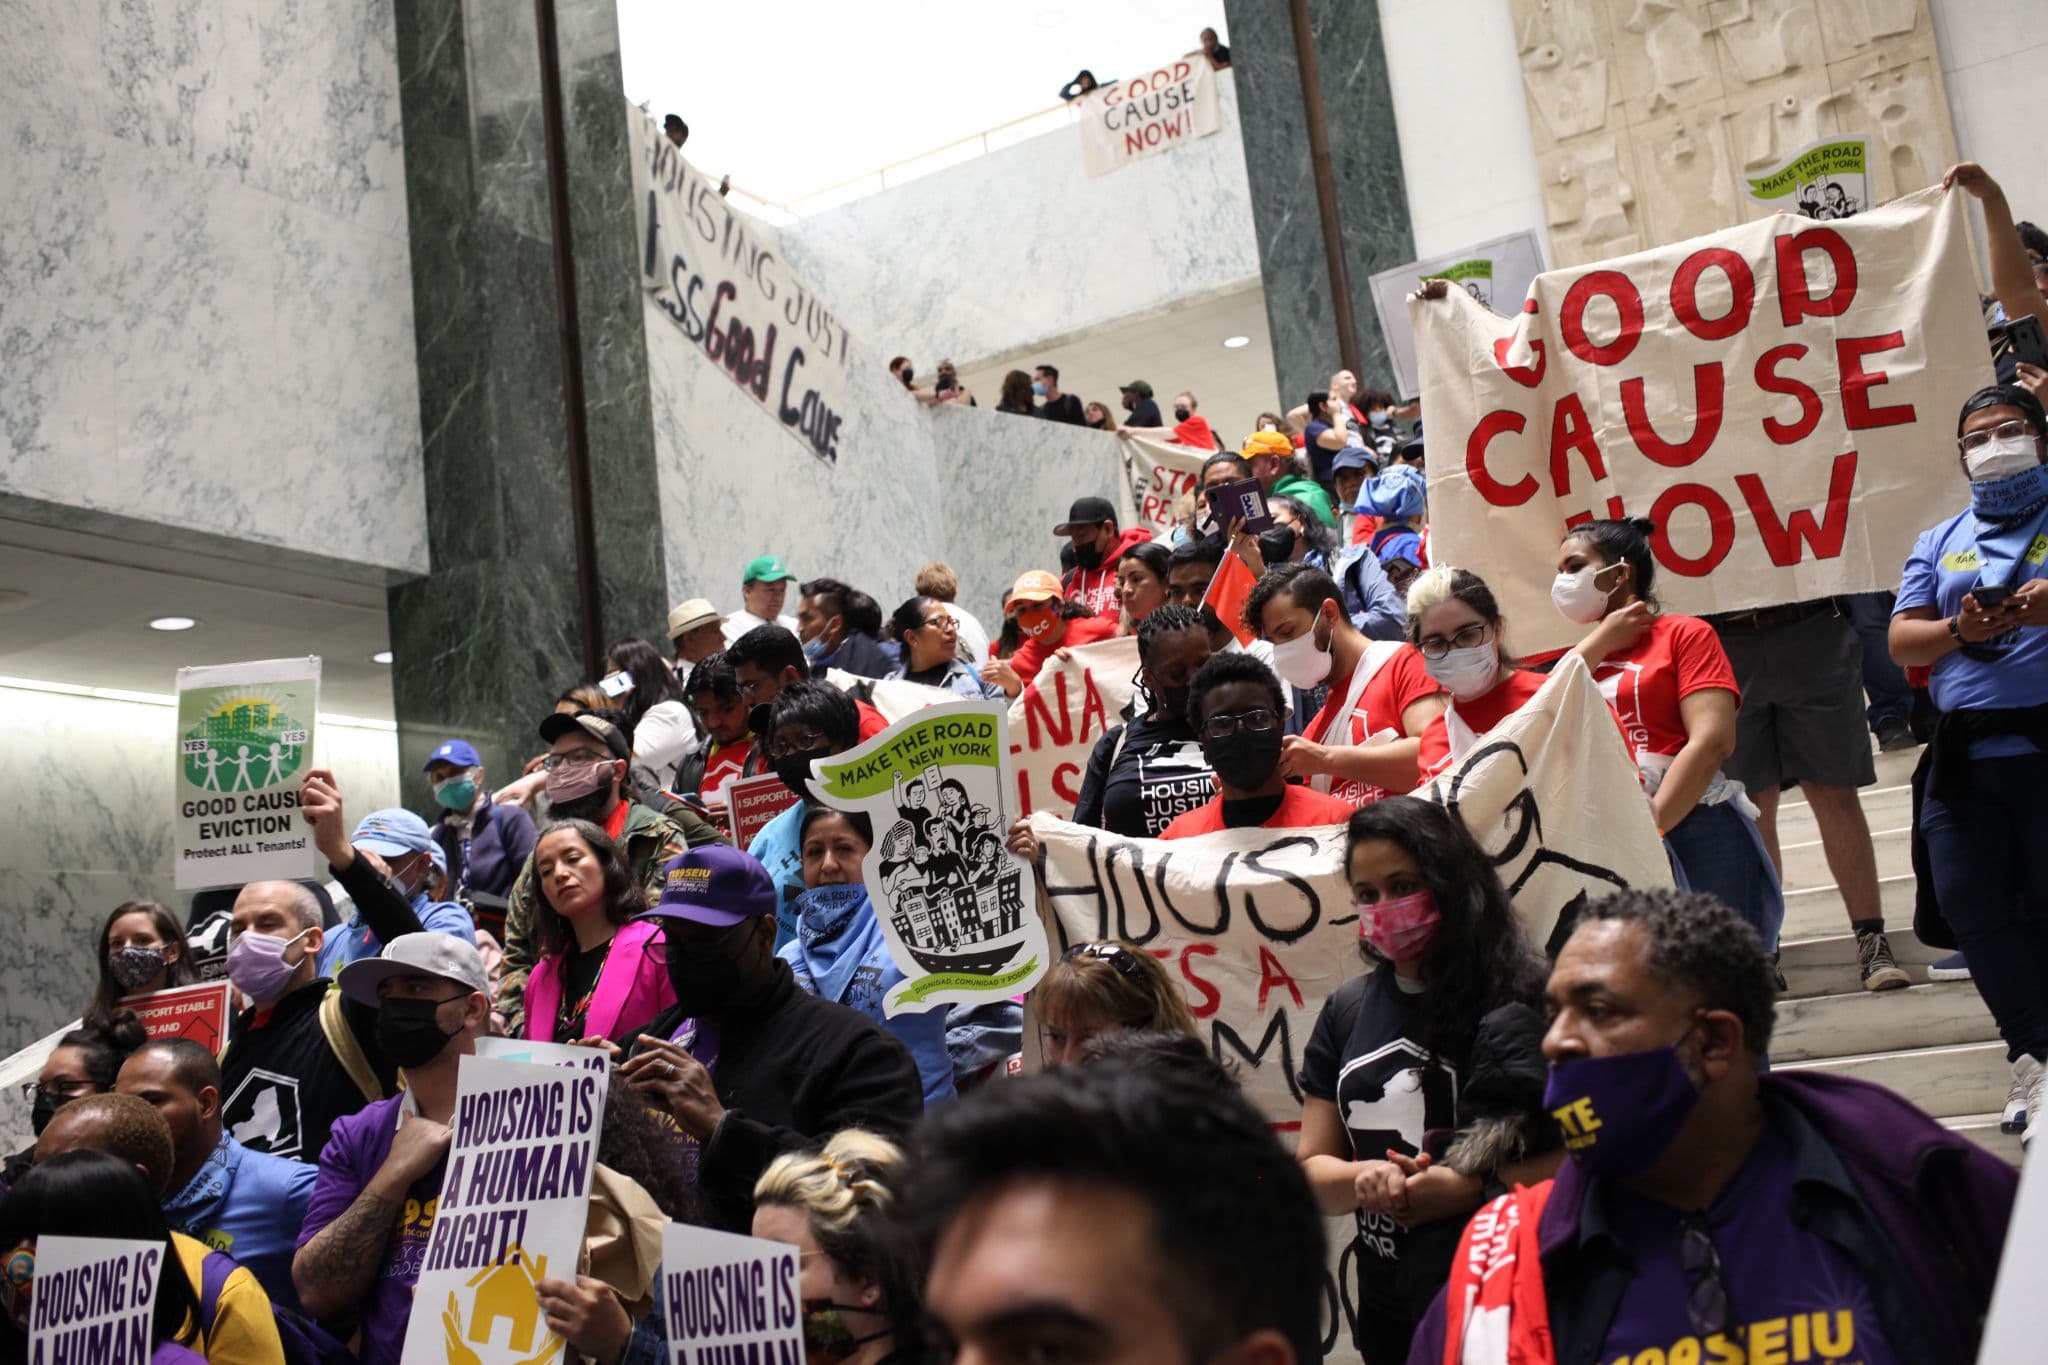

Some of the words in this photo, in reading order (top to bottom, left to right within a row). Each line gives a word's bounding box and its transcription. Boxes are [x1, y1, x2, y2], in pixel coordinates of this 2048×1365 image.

[1104, 62, 1190, 106] GOOD
[1104, 82, 1195, 130] CAUSE
[1125, 109, 1191, 155] NOW!
[1761, 169, 1796, 193] MAKE
[1795, 152, 1821, 173] THE
[1822, 146, 1862, 160] ROAD
[1806, 162, 1830, 179] NEW
[1833, 159, 1861, 169] YORK
[1494, 226, 1858, 388] GOOD
[1465, 331, 1917, 507] CAUSE
[184, 740, 206, 752] YES
[284, 731, 307, 743] YES
[840, 752, 893, 788] MAKE
[891, 728, 930, 760] THE
[933, 721, 993, 741] ROAD
[908, 744, 944, 770] NEW
[949, 742, 993, 758] YORK
[743, 789, 790, 808] SUPPORT
[1140, 778, 1217, 800] HOUSIN
[182, 797, 237, 818] GOOD
[740, 810, 776, 827] HOMES
[199, 814, 291, 840] EVICTION
[184, 846, 227, 860] Protect
[230, 843, 252, 855] ALL
[256, 837, 306, 853] Tenants!
[831, 888, 861, 900] ROAD
[914, 977, 953, 994] DIGNIDAD,
[954, 978, 999, 986] COMUNIDAD
[1007, 964, 1032, 982] PODER
[1258, 945, 1305, 1014] A
[175, 999, 215, 1014] STABLE
[158, 1022, 180, 1034] AND
[455, 1081, 564, 1150] HOUSING
[568, 1076, 595, 1135] IS
[441, 1155, 466, 1211] A
[465, 1140, 591, 1208] HUMAN
[426, 1208, 528, 1272] RIGHT!
[34, 1255, 129, 1332] HOUSING
[130, 1248, 159, 1309] IS
[668, 1258, 767, 1342] HOUSING
[771, 1253, 796, 1331] IS
